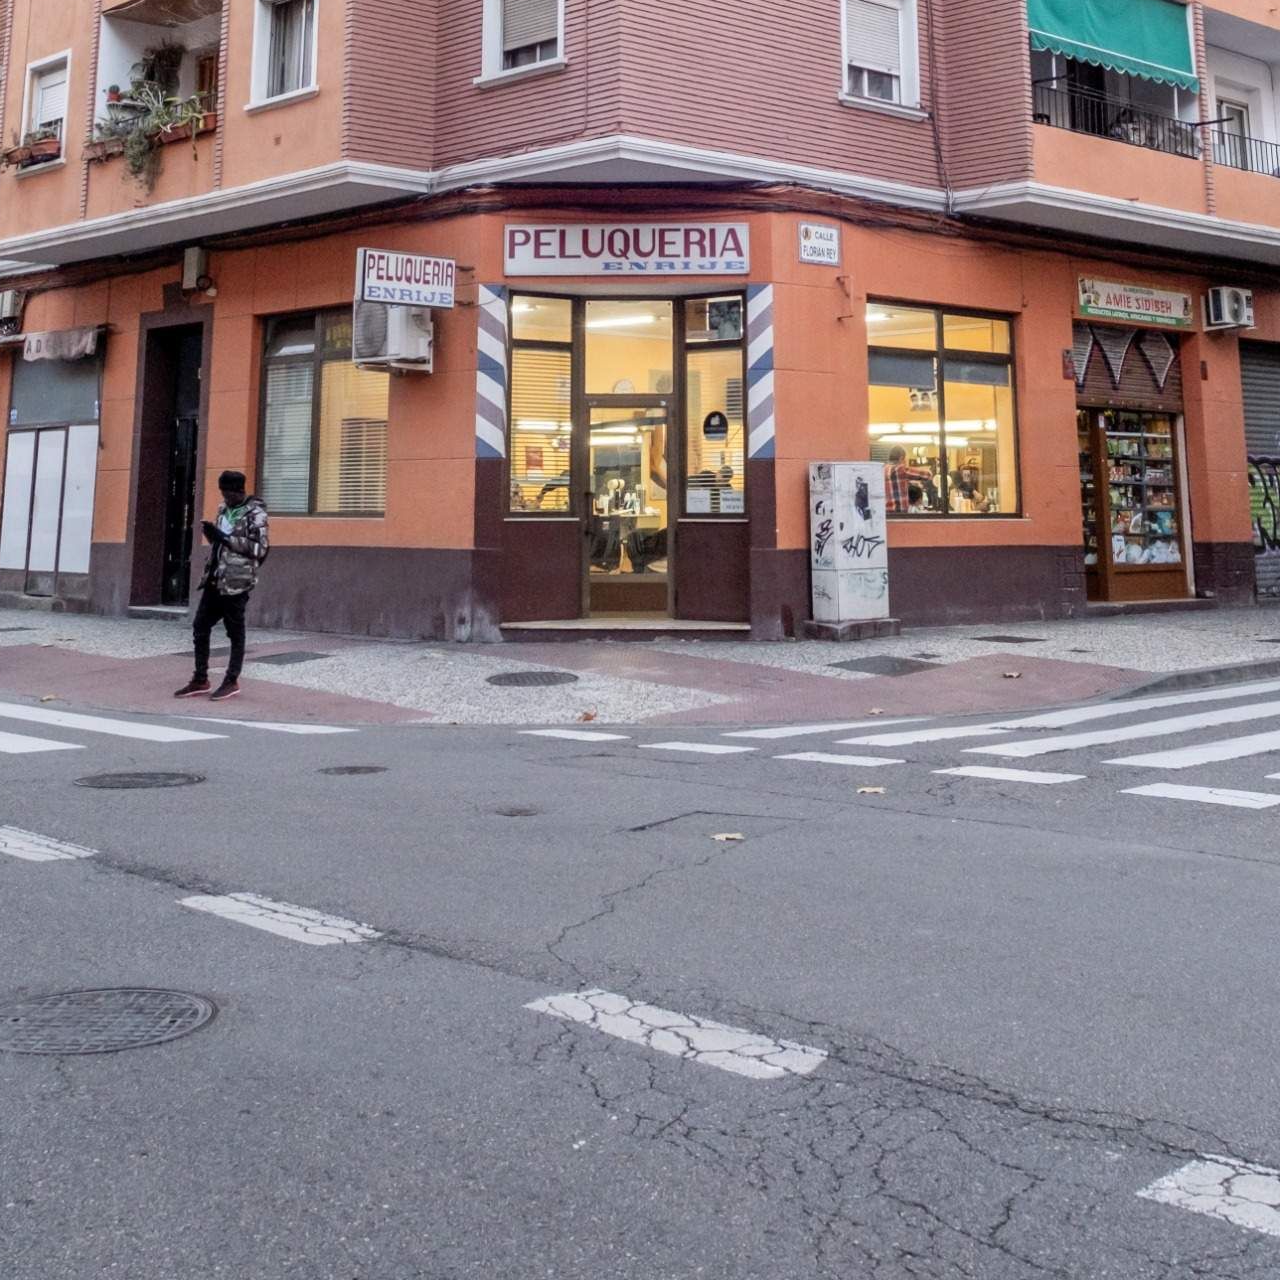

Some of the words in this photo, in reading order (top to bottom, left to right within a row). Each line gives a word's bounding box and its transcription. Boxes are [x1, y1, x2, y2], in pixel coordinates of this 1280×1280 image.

[508, 228, 744, 259] PELUQUERIA
[815, 231, 833, 241] CALLE
[366, 253, 454, 287] PELUQUERIA
[602, 261, 745, 271] ENRIJE
[367, 286, 452, 305] ENRIJE
[1105, 292, 1132, 308] AMIE
